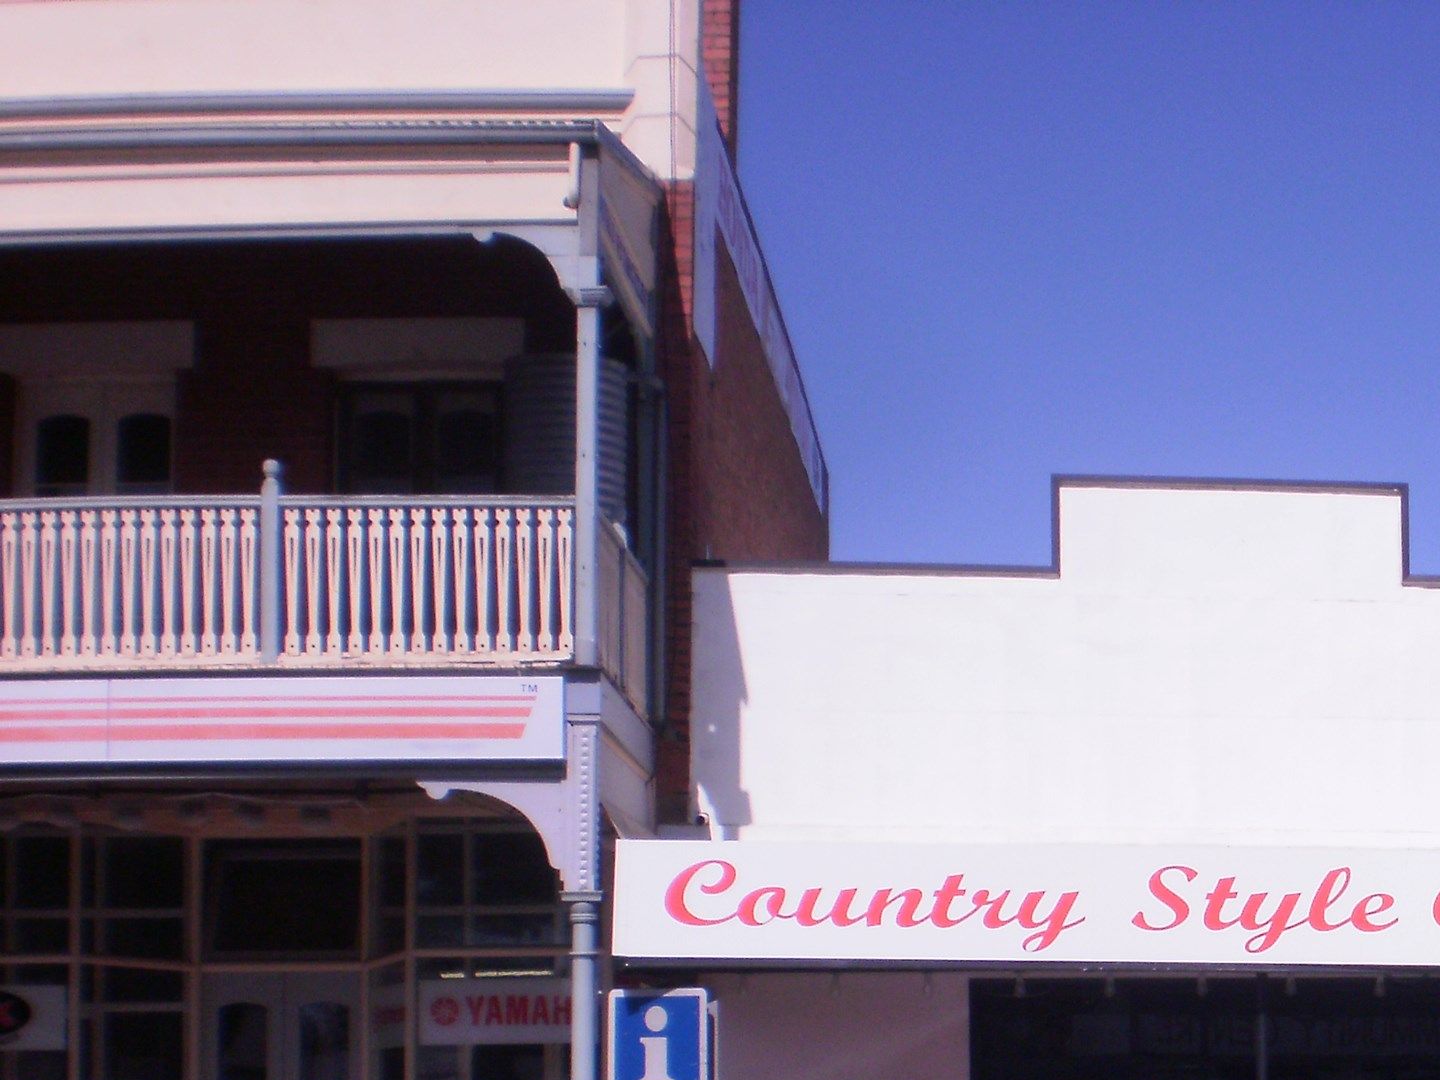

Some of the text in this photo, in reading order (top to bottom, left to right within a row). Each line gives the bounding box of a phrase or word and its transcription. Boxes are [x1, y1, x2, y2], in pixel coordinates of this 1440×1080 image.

[664, 859, 1086, 953] Country
[1132, 866, 1399, 954] Style
[466, 995, 572, 1026] YAMAH
